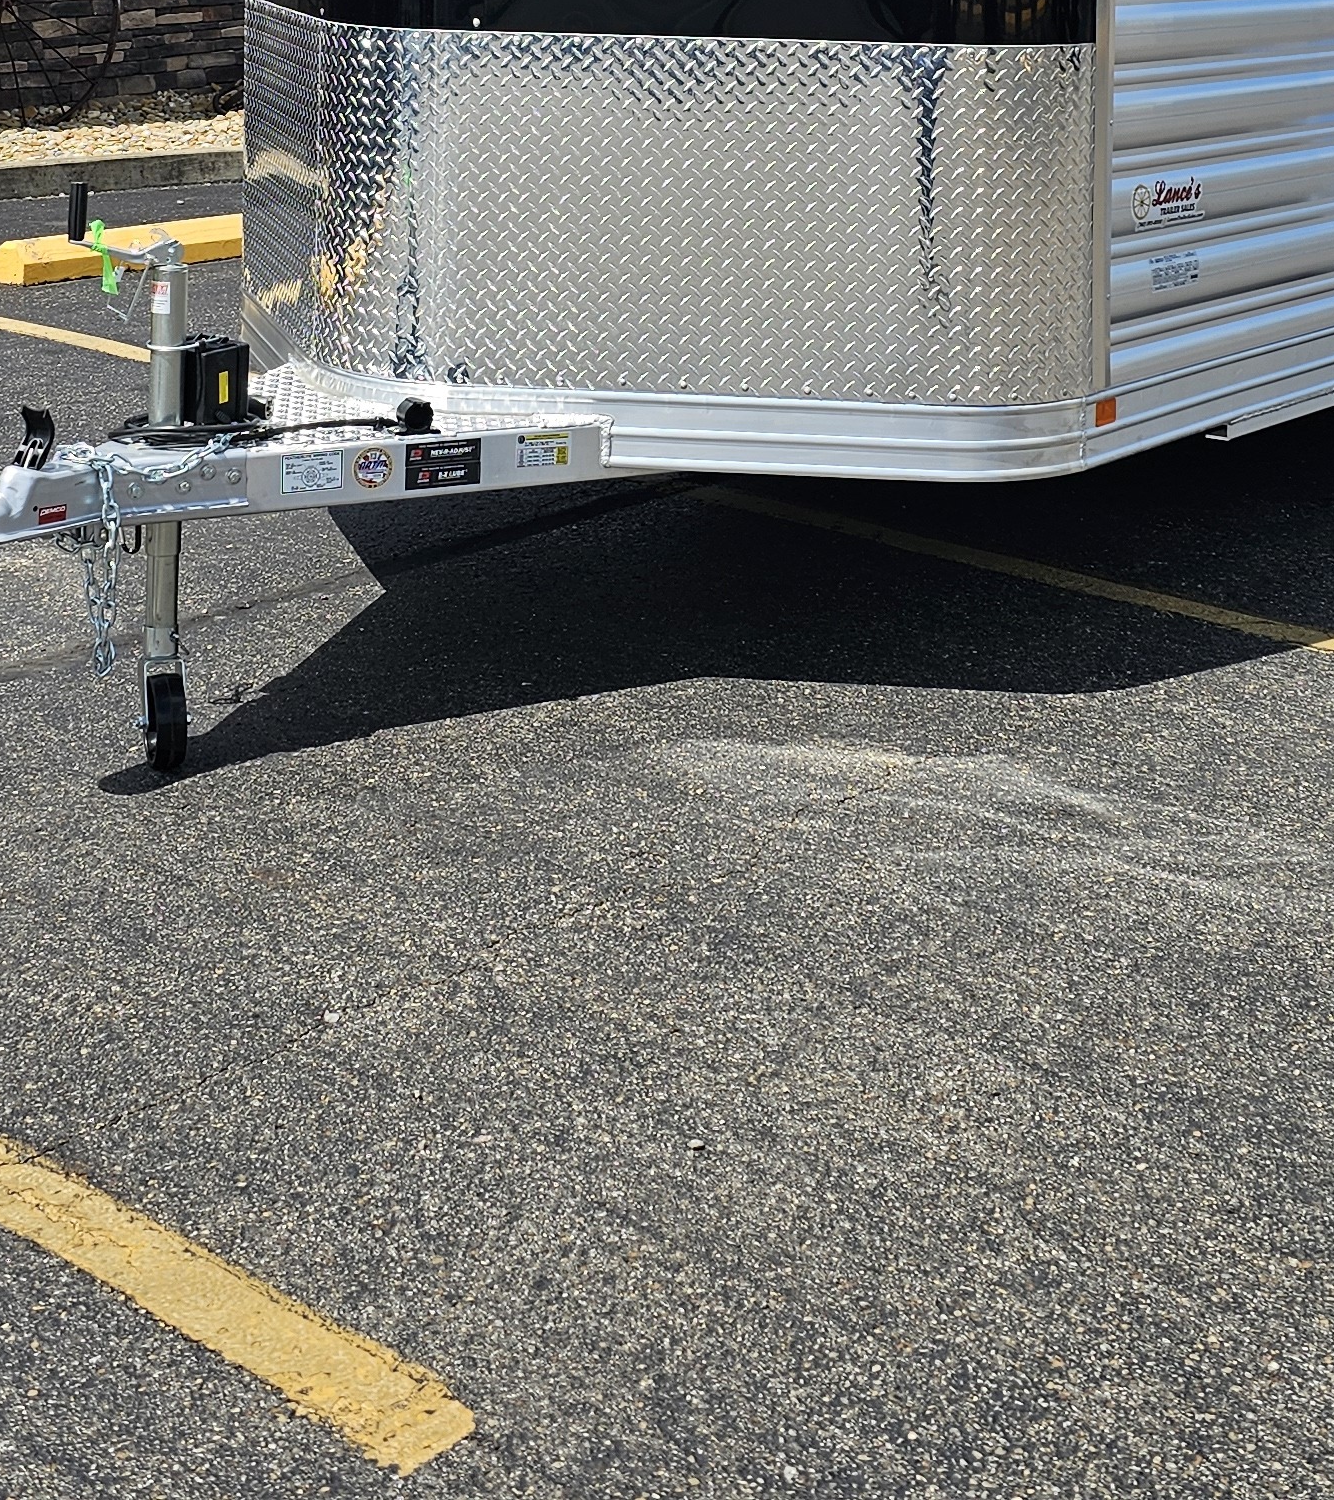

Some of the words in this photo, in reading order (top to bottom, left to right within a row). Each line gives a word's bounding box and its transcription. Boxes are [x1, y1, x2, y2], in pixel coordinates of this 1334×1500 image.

[1152, 176, 1201, 206] Lance's
[1160, 205, 1180, 216] TRAILER
[1181, 202, 1196, 213] SALES
[40, 505, 65, 516] DEMCO
